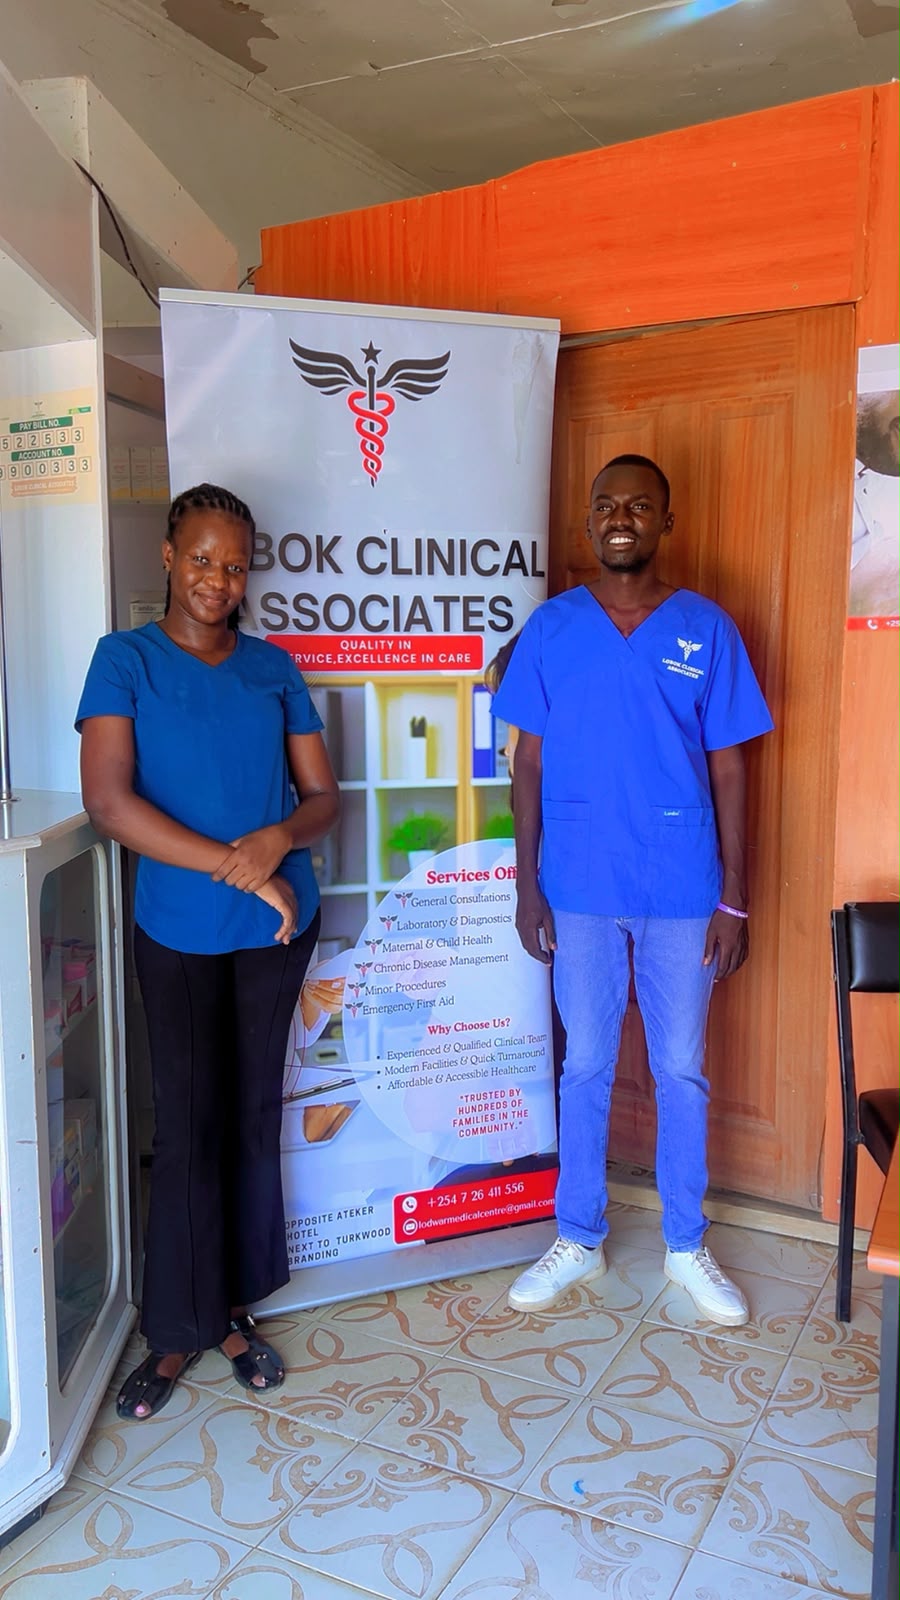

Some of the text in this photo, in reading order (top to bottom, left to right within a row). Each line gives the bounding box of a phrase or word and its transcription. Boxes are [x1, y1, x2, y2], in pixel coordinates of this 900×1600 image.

[19, 418, 60, 430] PAY BILL NO.
[18, 448, 64, 460] ACCOUNT NO.
[249, 532, 545, 578] BOK CLINICAL
[340, 639, 411, 650] QUALITY IN
[290, 653, 471, 664] RVICE,EXCELLENCE IN CARE
[427, 865, 517, 884] Services Off
[411, 892, 511, 907] General Consultations
[397, 913, 512, 932] Laboratory & Diagnostics
[382, 935, 493, 953] Maternal & Child Health
[374, 953, 509, 973] Chronic Disease Management
[365, 979, 447, 996] Minor Procedures
[362, 995, 455, 1015] Emergency First Aid
[427, 1018, 511, 1036] Why Choose Us?
[387, 1033, 547, 1061] Experienced & Qualified Clinical Team
[384, 1047, 546, 1076] Modern Facilities & Quick Turnaround
[387, 1063, 537, 1090] Affordable & Accessible Healthcare
[509, 1088, 521, 1097] BY
[458, 1099, 523, 1115] HUNDREDS OF
[453, 1109, 529, 1127] FAMILIES IN THE
[427, 1181, 525, 1208] +254 7 26 411 556
[285, 1206, 374, 1230] OPPOSITE ATEKER
[418, 1198, 556, 1229] lodwarmedicalcentre@gmail.com
[287, 1228, 319, 1240] HOTEL
[288, 1227, 391, 1254] NEXT TO TURKWOOD
[288, 1248, 339, 1265] BRANDING
